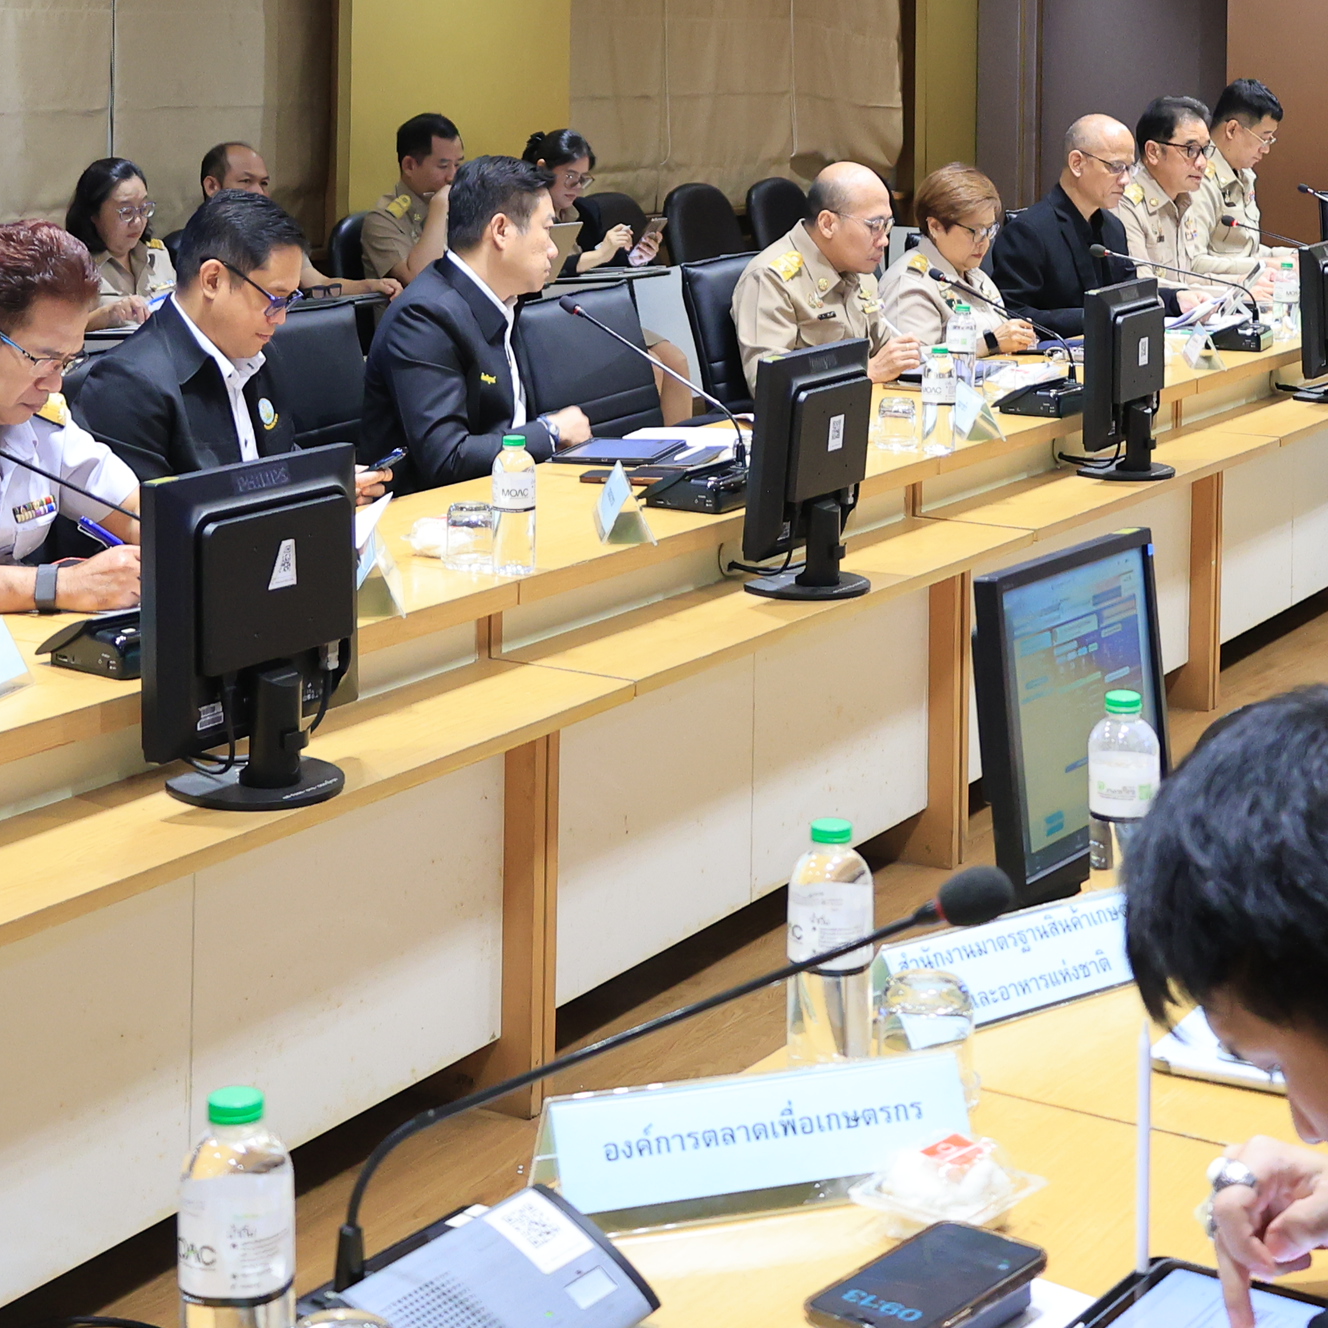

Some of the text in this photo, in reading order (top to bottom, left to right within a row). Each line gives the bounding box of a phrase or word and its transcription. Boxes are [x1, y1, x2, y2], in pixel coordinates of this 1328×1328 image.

[603, 1099, 925, 1163] องค์การตลาดเพื่อเกษตรกร
[841, 1288, 924, 1322] 09:13
